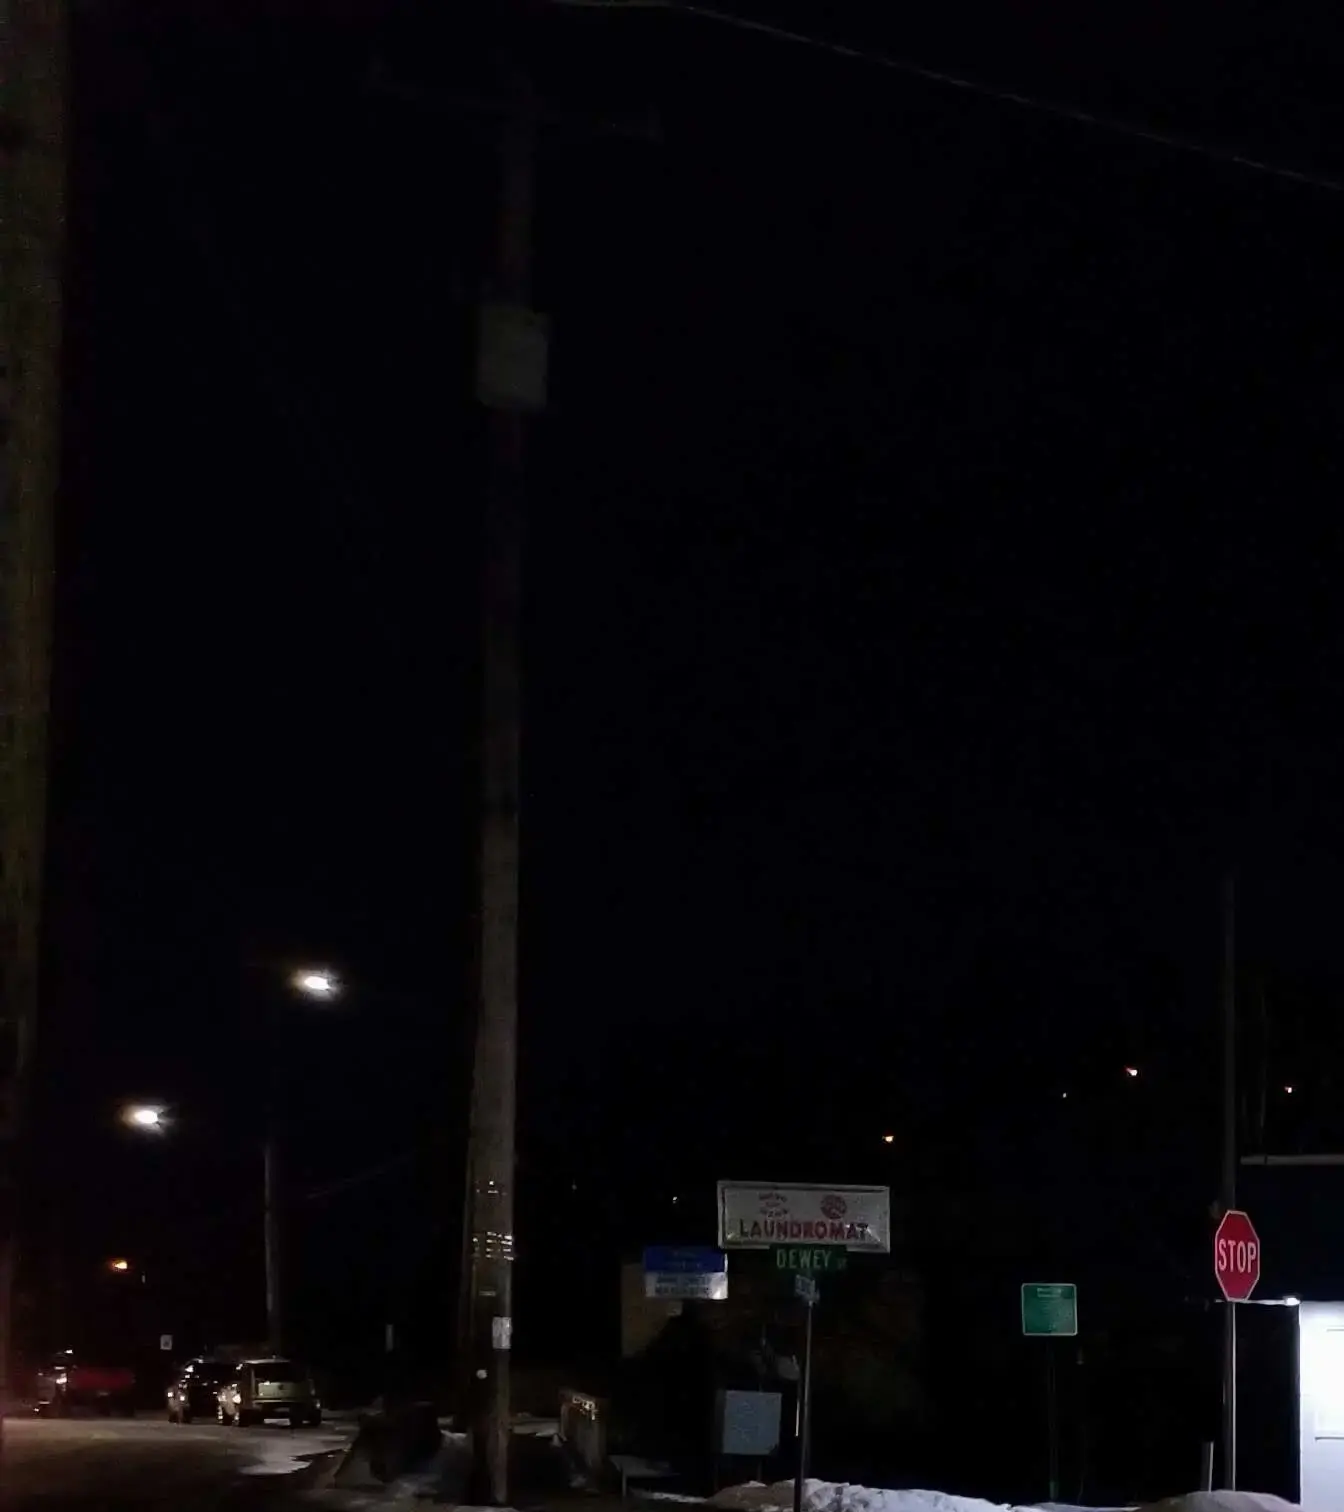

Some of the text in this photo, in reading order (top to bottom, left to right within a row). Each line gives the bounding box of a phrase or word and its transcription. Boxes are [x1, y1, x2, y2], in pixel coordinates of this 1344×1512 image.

[739, 1218, 869, 1241] LAUNDROMAT
[776, 1248, 832, 1270] DEWEY
[1218, 1238, 1257, 1273] STOP
